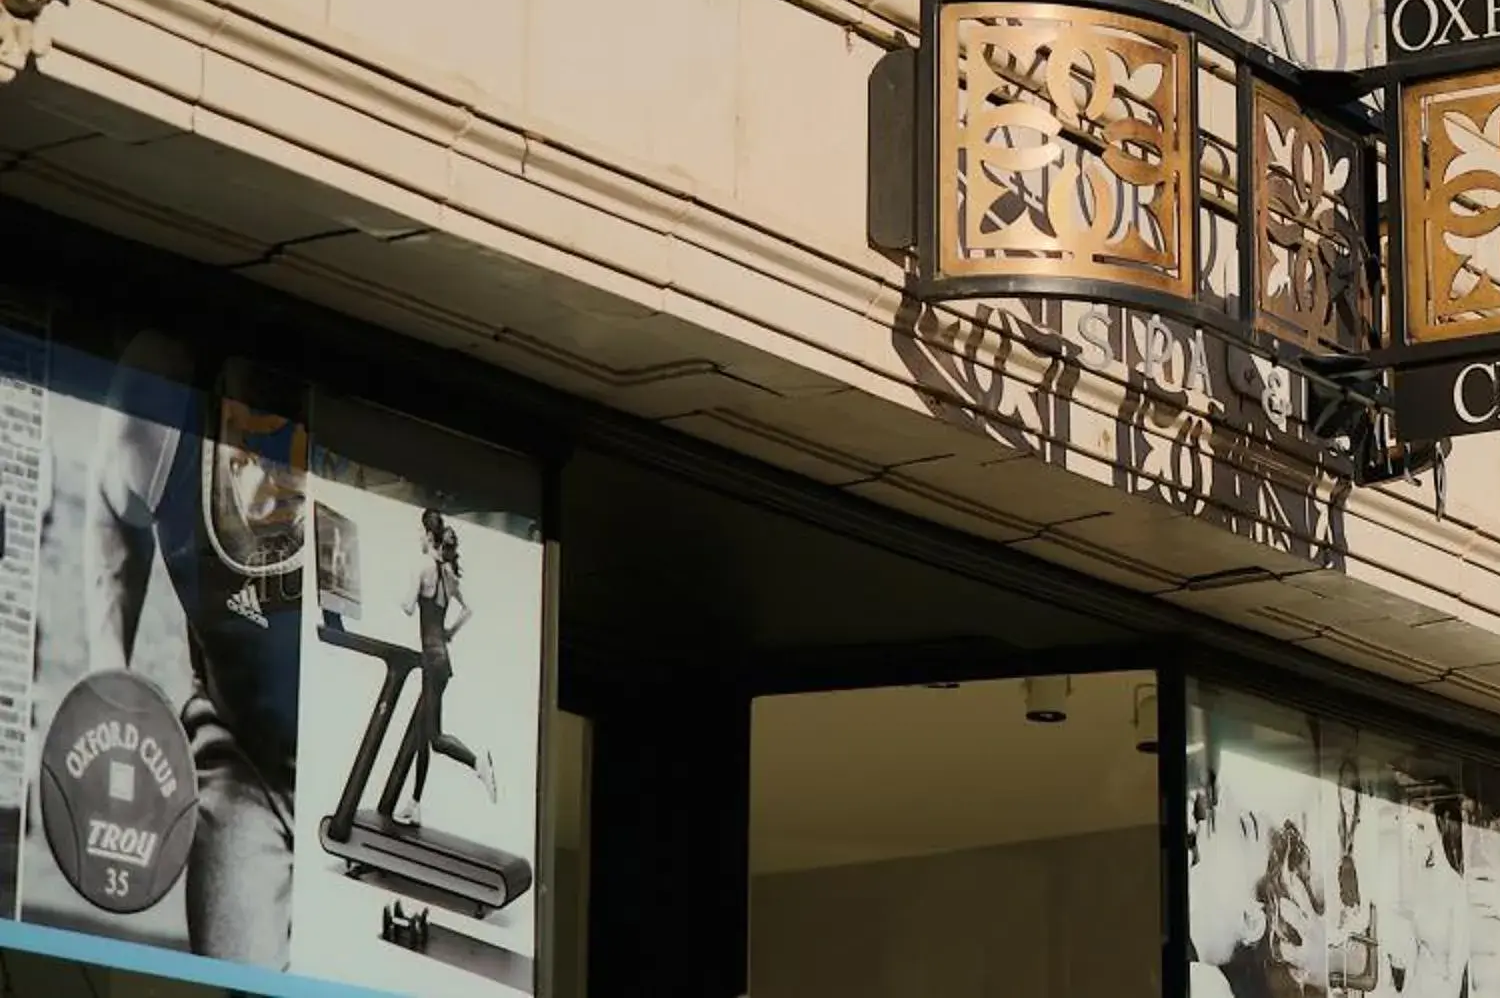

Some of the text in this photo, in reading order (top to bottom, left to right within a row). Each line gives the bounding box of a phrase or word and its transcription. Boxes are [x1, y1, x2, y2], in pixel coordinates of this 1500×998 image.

[1077, 305, 1214, 398] SPA
[66, 720, 177, 798] OXFORD CLUB
[104, 867, 129, 897] 35
